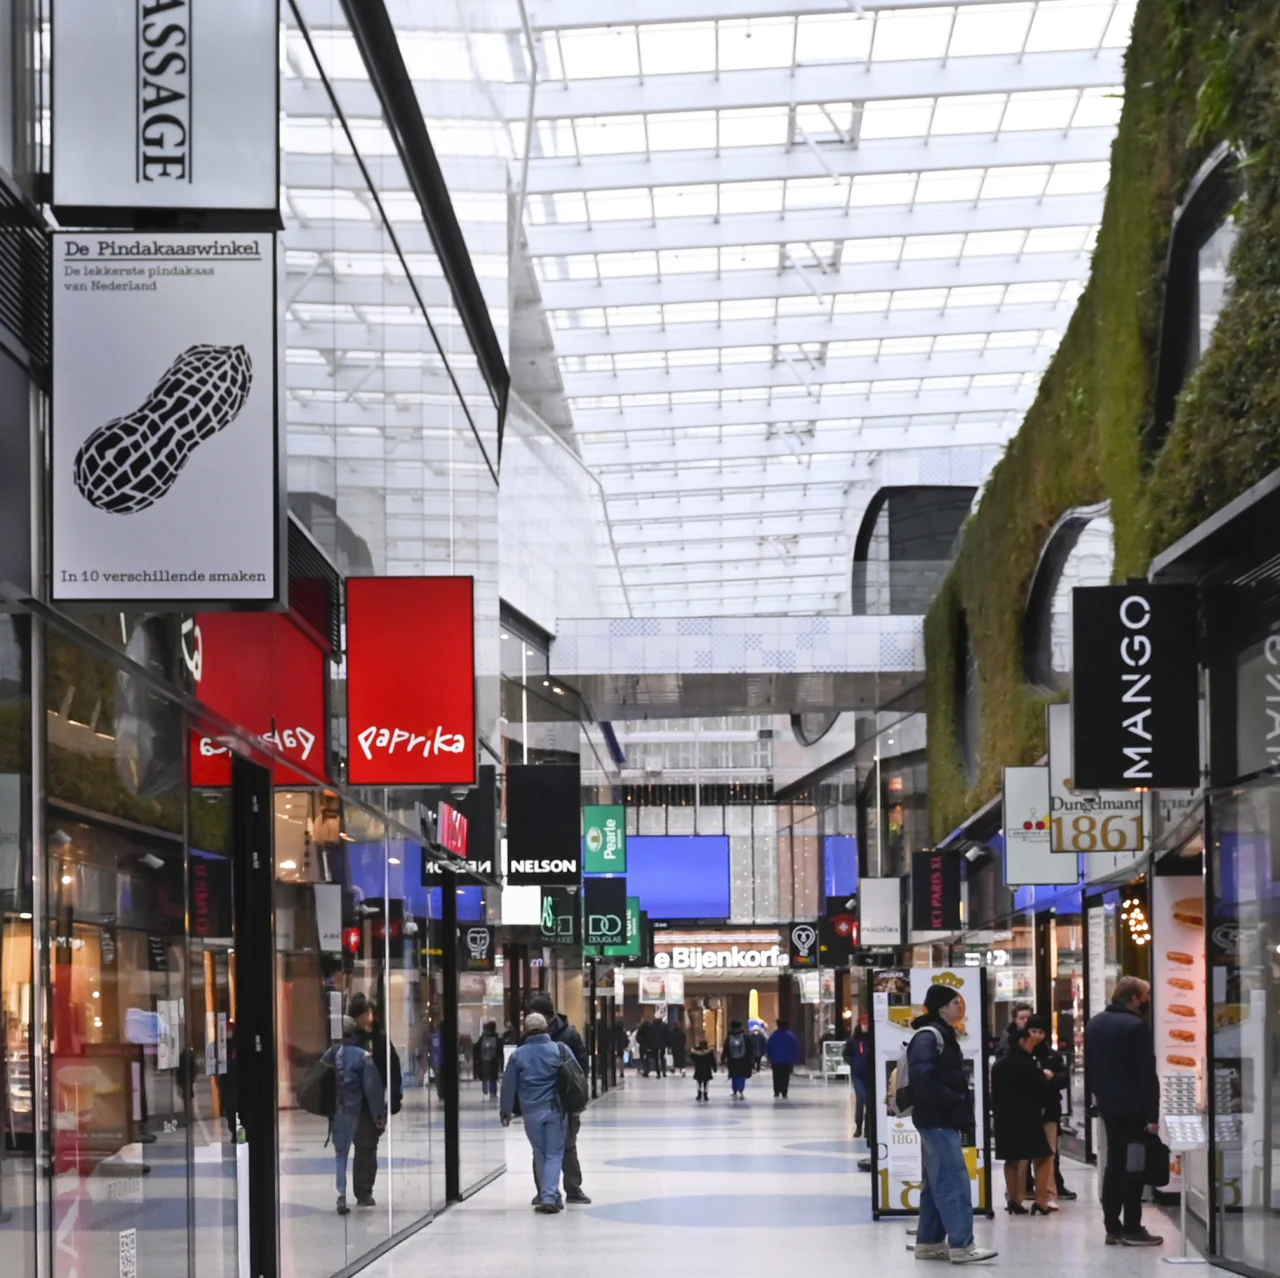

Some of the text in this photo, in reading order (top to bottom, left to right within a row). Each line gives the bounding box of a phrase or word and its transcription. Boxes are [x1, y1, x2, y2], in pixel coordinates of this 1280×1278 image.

[65, 240, 261, 256] De Pindakaaswinkel
[64, 265, 215, 279] De lekkerste pindakaas
[64, 280, 157, 292] van Nederland
[61, 570, 266, 583] In 10 verschillende smaken
[1119, 595, 1153, 780] MANGO
[603, 818, 617, 860] Pearle
[510, 860, 577, 873] NELSON
[672, 945, 780, 973] Bijenkorf
